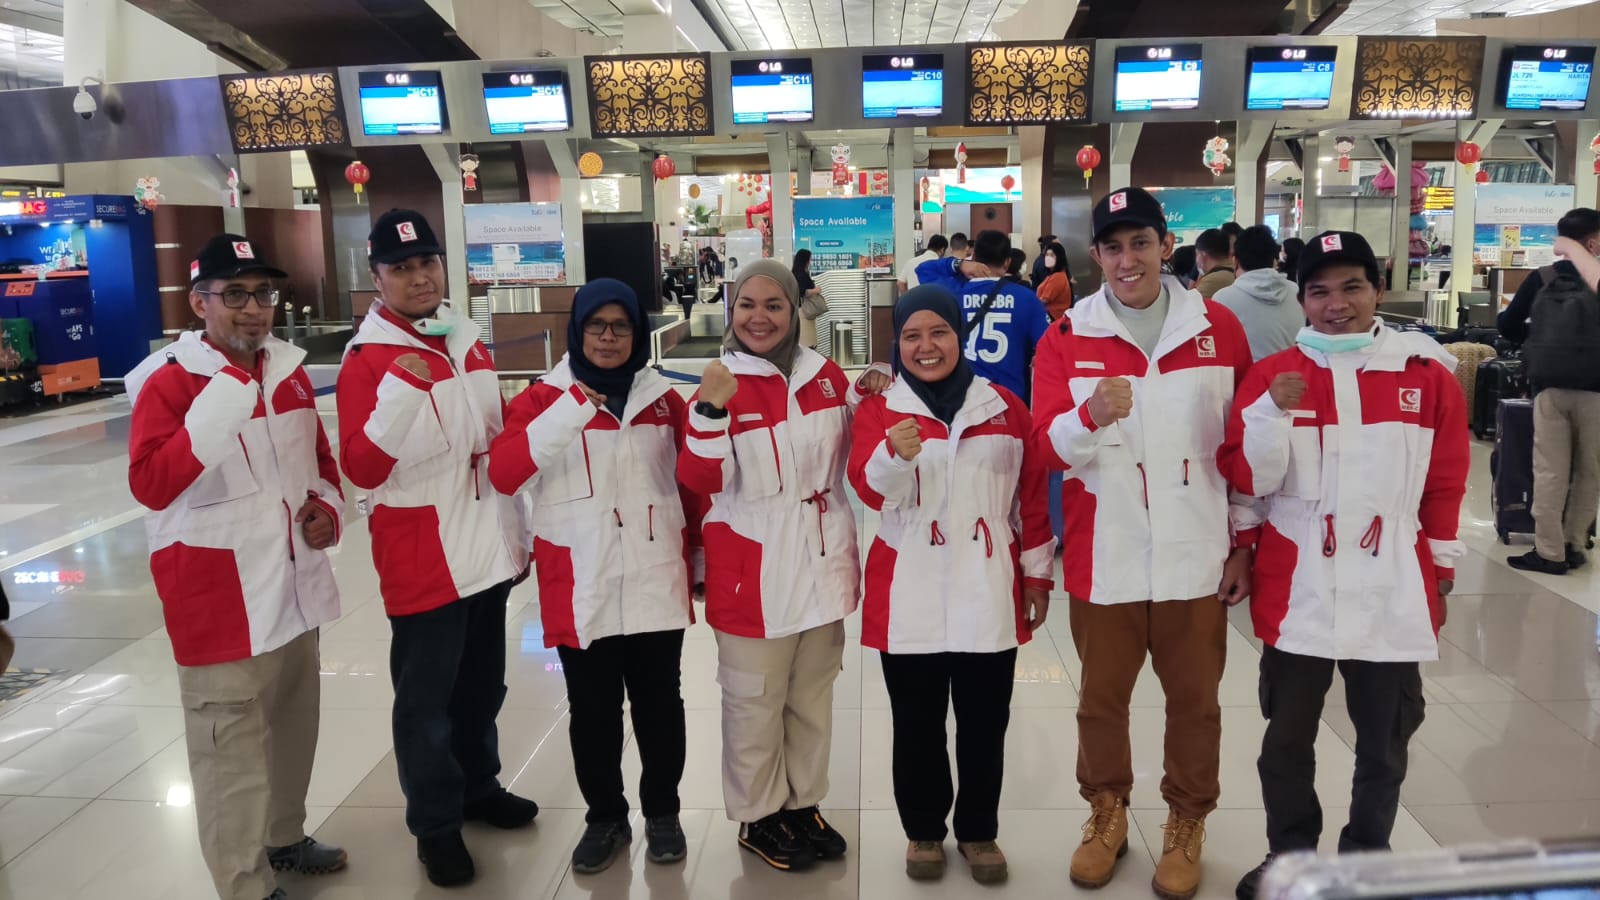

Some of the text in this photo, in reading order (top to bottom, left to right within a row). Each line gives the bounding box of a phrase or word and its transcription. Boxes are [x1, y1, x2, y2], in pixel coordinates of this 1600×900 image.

[1158, 49, 1172, 58] LG
[1293, 49, 1306, 58] LG
[1553, 49, 1567, 58] LG
[901, 57, 914, 66] LG
[769, 62, 782, 72] LG
[1317, 63, 1330, 72] C8
[1576, 64, 1589, 72] C7
[396, 74, 409, 83] LG
[521, 75, 534, 84] LG
[793, 75, 810, 84] C11
[924, 71, 942, 80] C10
[1494, 205, 1553, 215] Space Available
[800, 217, 867, 227] Space Available
[483, 224, 542, 233] Space Available
